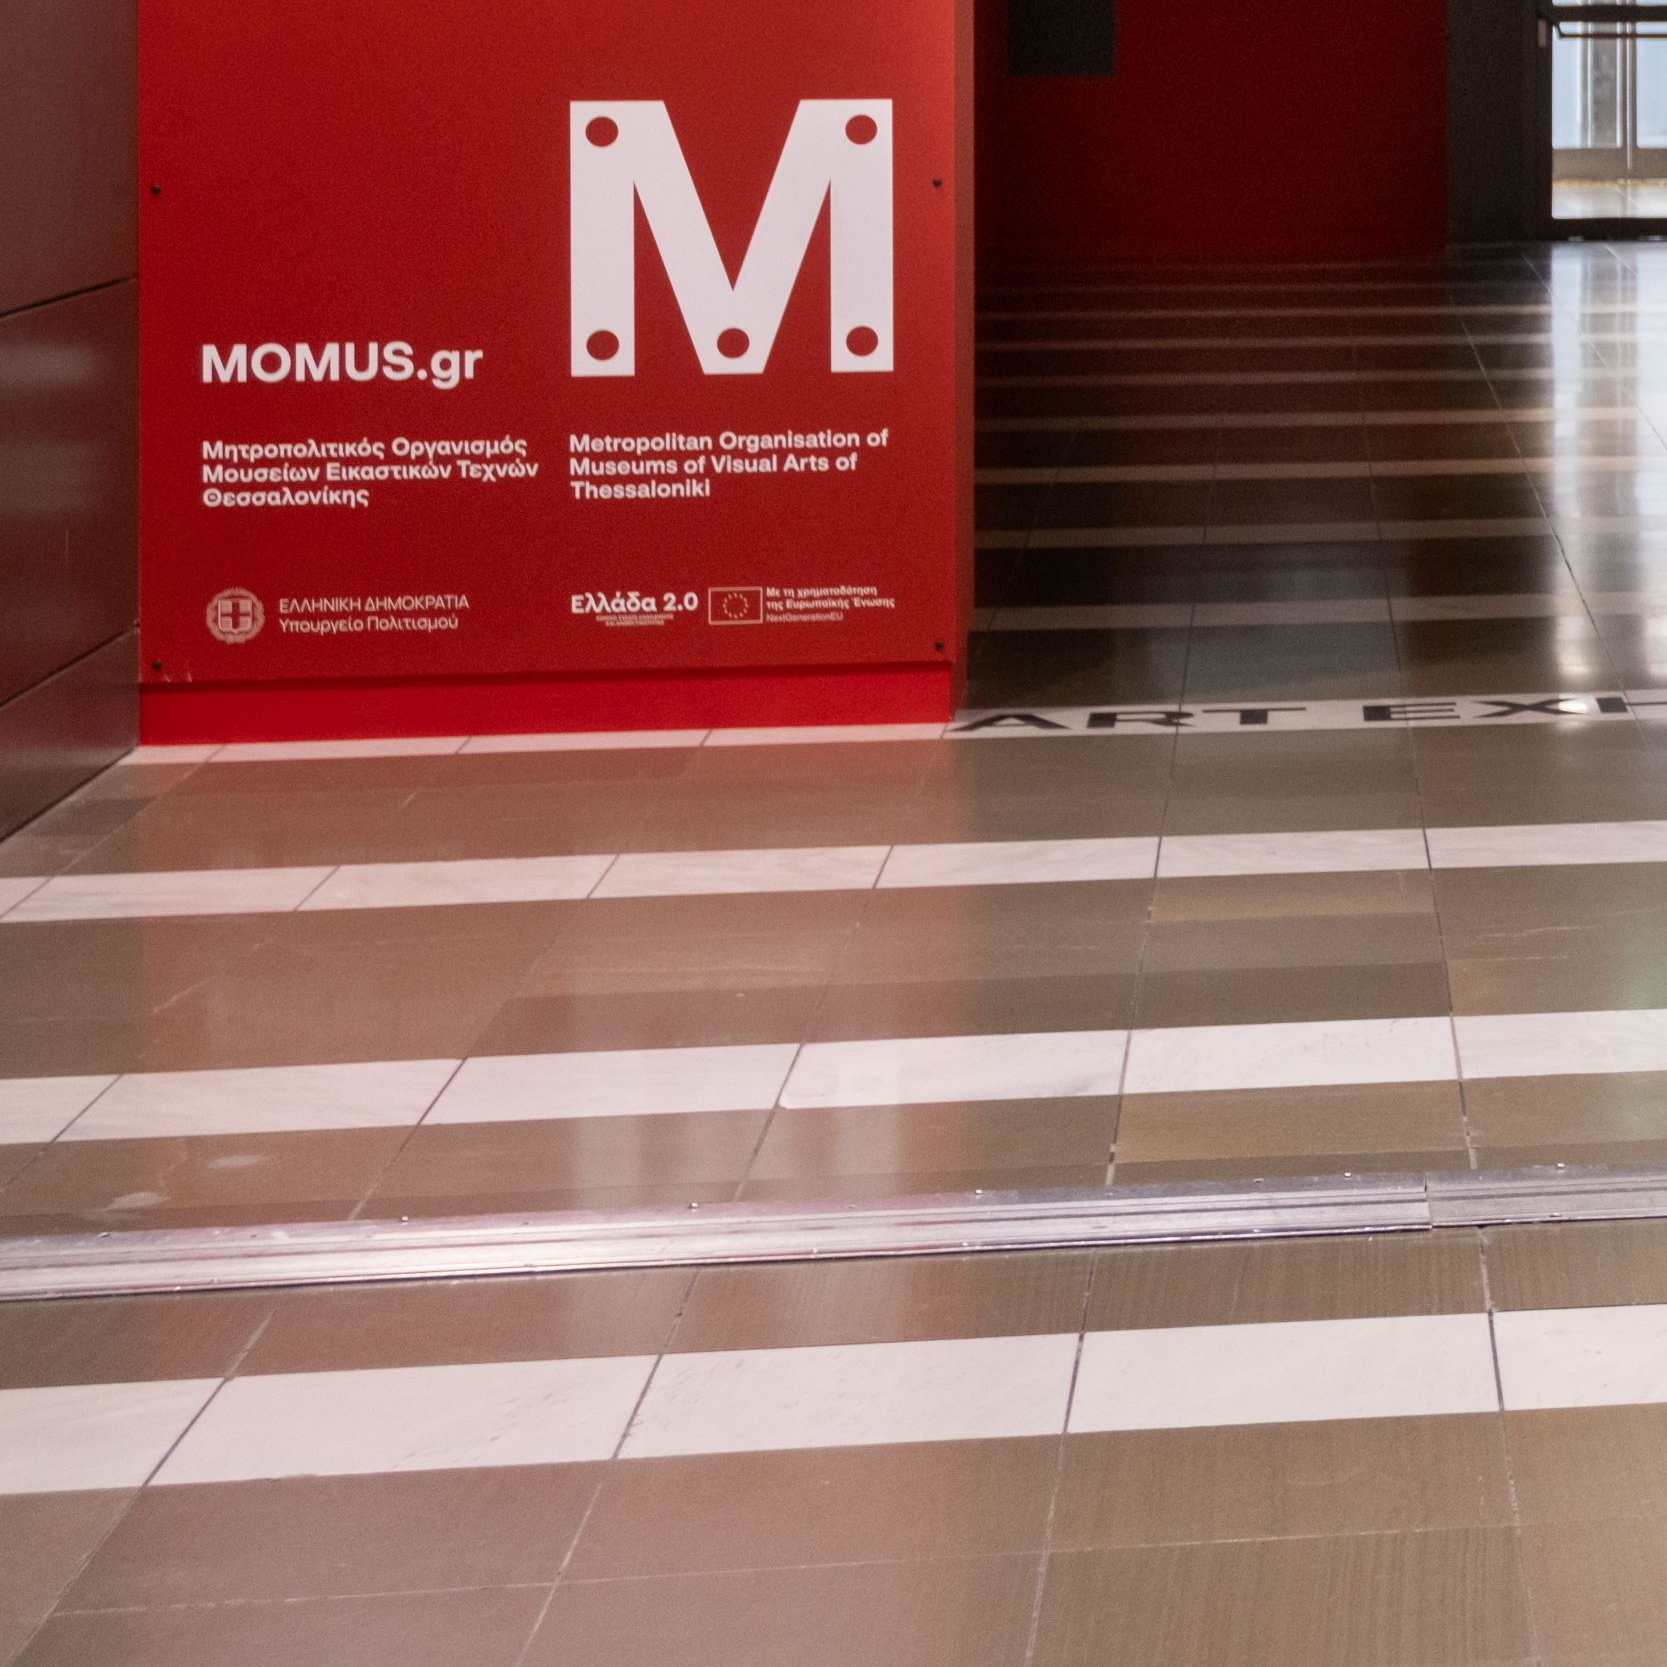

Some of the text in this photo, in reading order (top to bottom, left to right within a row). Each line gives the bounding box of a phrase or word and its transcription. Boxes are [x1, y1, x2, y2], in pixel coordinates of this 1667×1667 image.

[570, 99, 894, 377] M
[201, 341, 484, 389] MOMUS.gr
[202, 435, 528, 462] Μητροπολιτικός Οργανισμός
[569, 429, 889, 455] Metropolitan Organisation of
[202, 459, 539, 483] Μουσείων Εικαστικών Τεχνών
[569, 452, 858, 475] Museums of Visual Arts of
[202, 486, 370, 508] Θεσσαλονίκης
[570, 479, 711, 500] Thessaloniki
[279, 594, 470, 613] ΕΛΛΗΝΙΚΗ ΔΗΜΟΚΡΑΤΙΑ
[571, 591, 699, 614] Ελλάδα 2.0
[279, 614, 459, 635] Υπουργείο Πολιτισμού
[766, 612, 844, 623] NextGenerationEU
[950, 706, 1306, 732] ART
